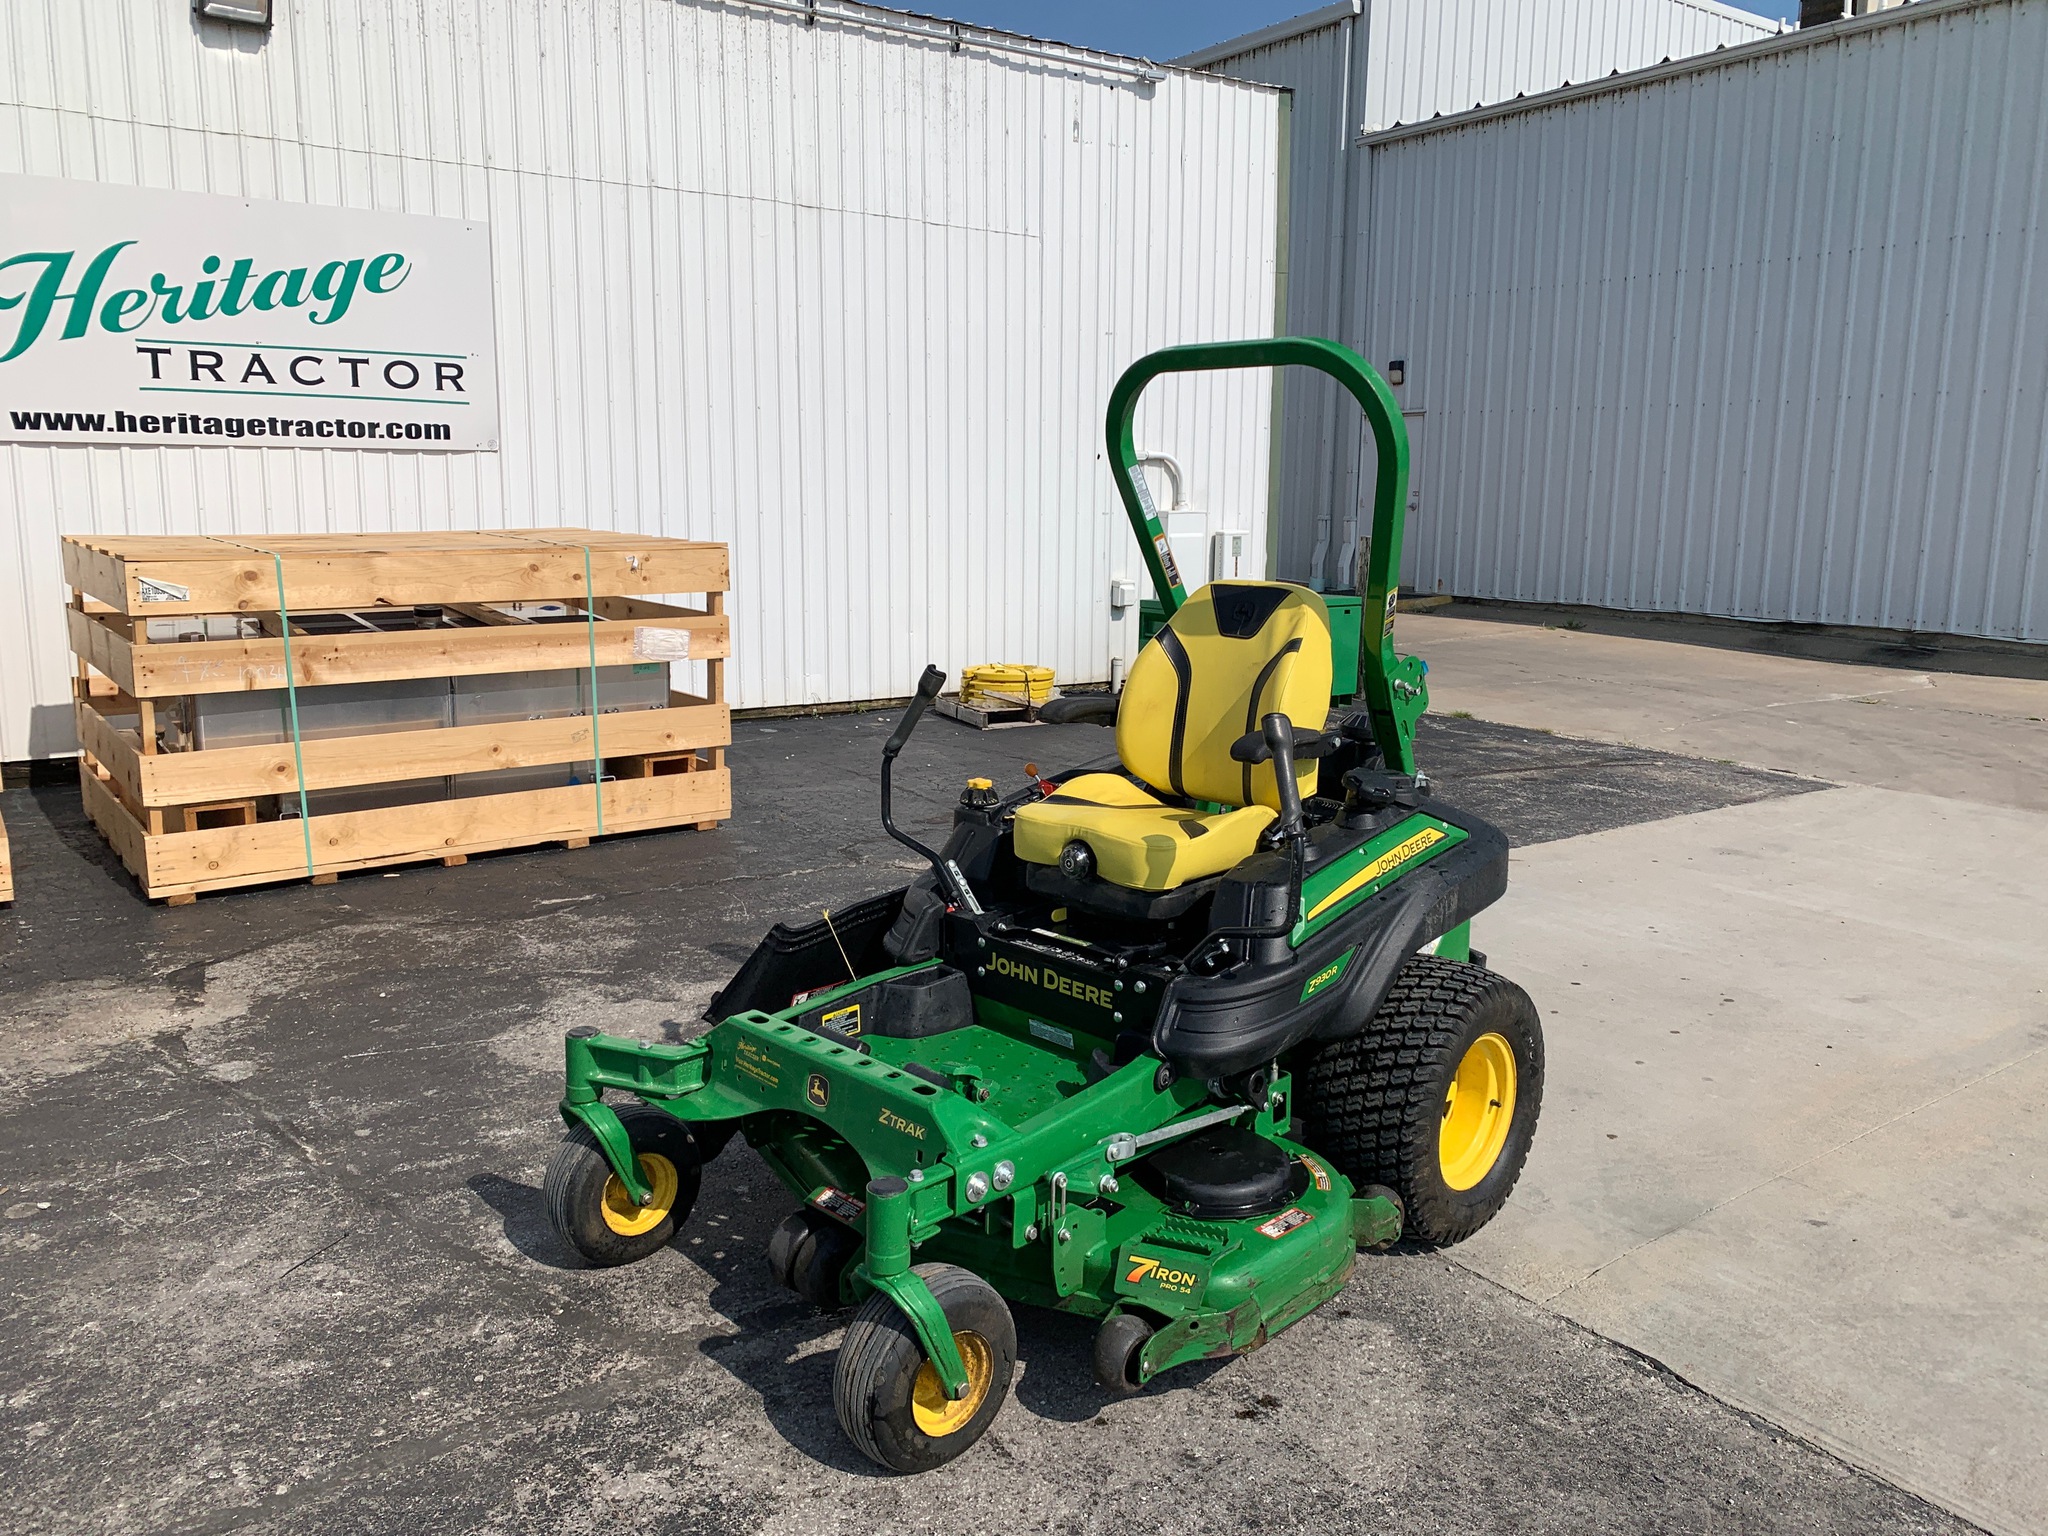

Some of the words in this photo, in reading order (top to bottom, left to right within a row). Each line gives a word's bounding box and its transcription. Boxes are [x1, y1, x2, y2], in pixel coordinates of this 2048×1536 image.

[0, 240, 413, 363] Heritage
[136, 346, 466, 392] TRACTOR
[9, 409, 451, 440] www.heritagetractor.com
[1376, 851, 1402, 875] JOHN
[1401, 832, 1434, 858] DEERE
[986, 952, 1038, 985] JOHN
[1043, 968, 1113, 1009] DEERE
[1307, 965, 1338, 994] Z930R
[878, 1107, 926, 1140] ZTRAK
[1160, 1282, 1178, 1292] PRO
[1179, 1286, 1191, 1295] 54
